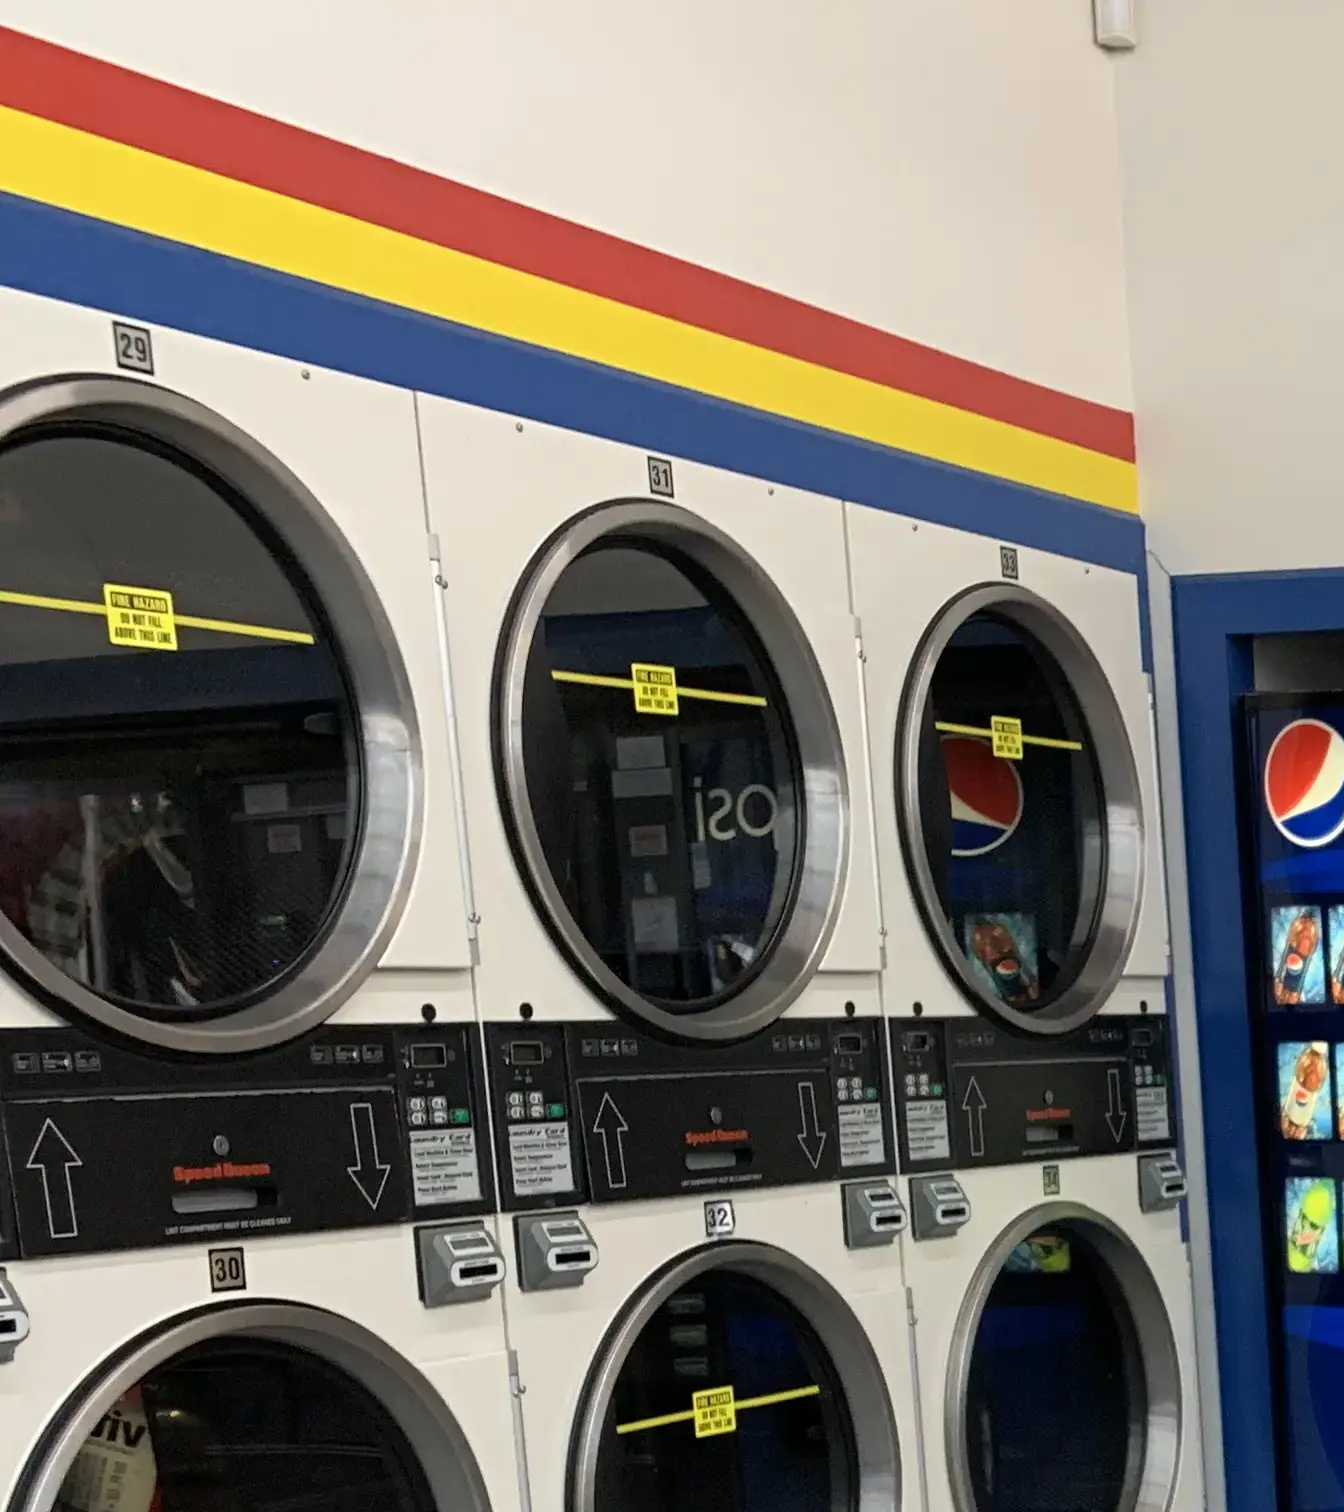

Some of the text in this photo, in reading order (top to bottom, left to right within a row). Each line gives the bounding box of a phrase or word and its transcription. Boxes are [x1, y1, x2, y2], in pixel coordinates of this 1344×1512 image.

[118, 332, 149, 362] 29
[652, 465, 670, 487] 31
[173, 1161, 271, 1185] Speed Queen
[707, 1208, 729, 1227] 32
[214, 1257, 240, 1283] 30
